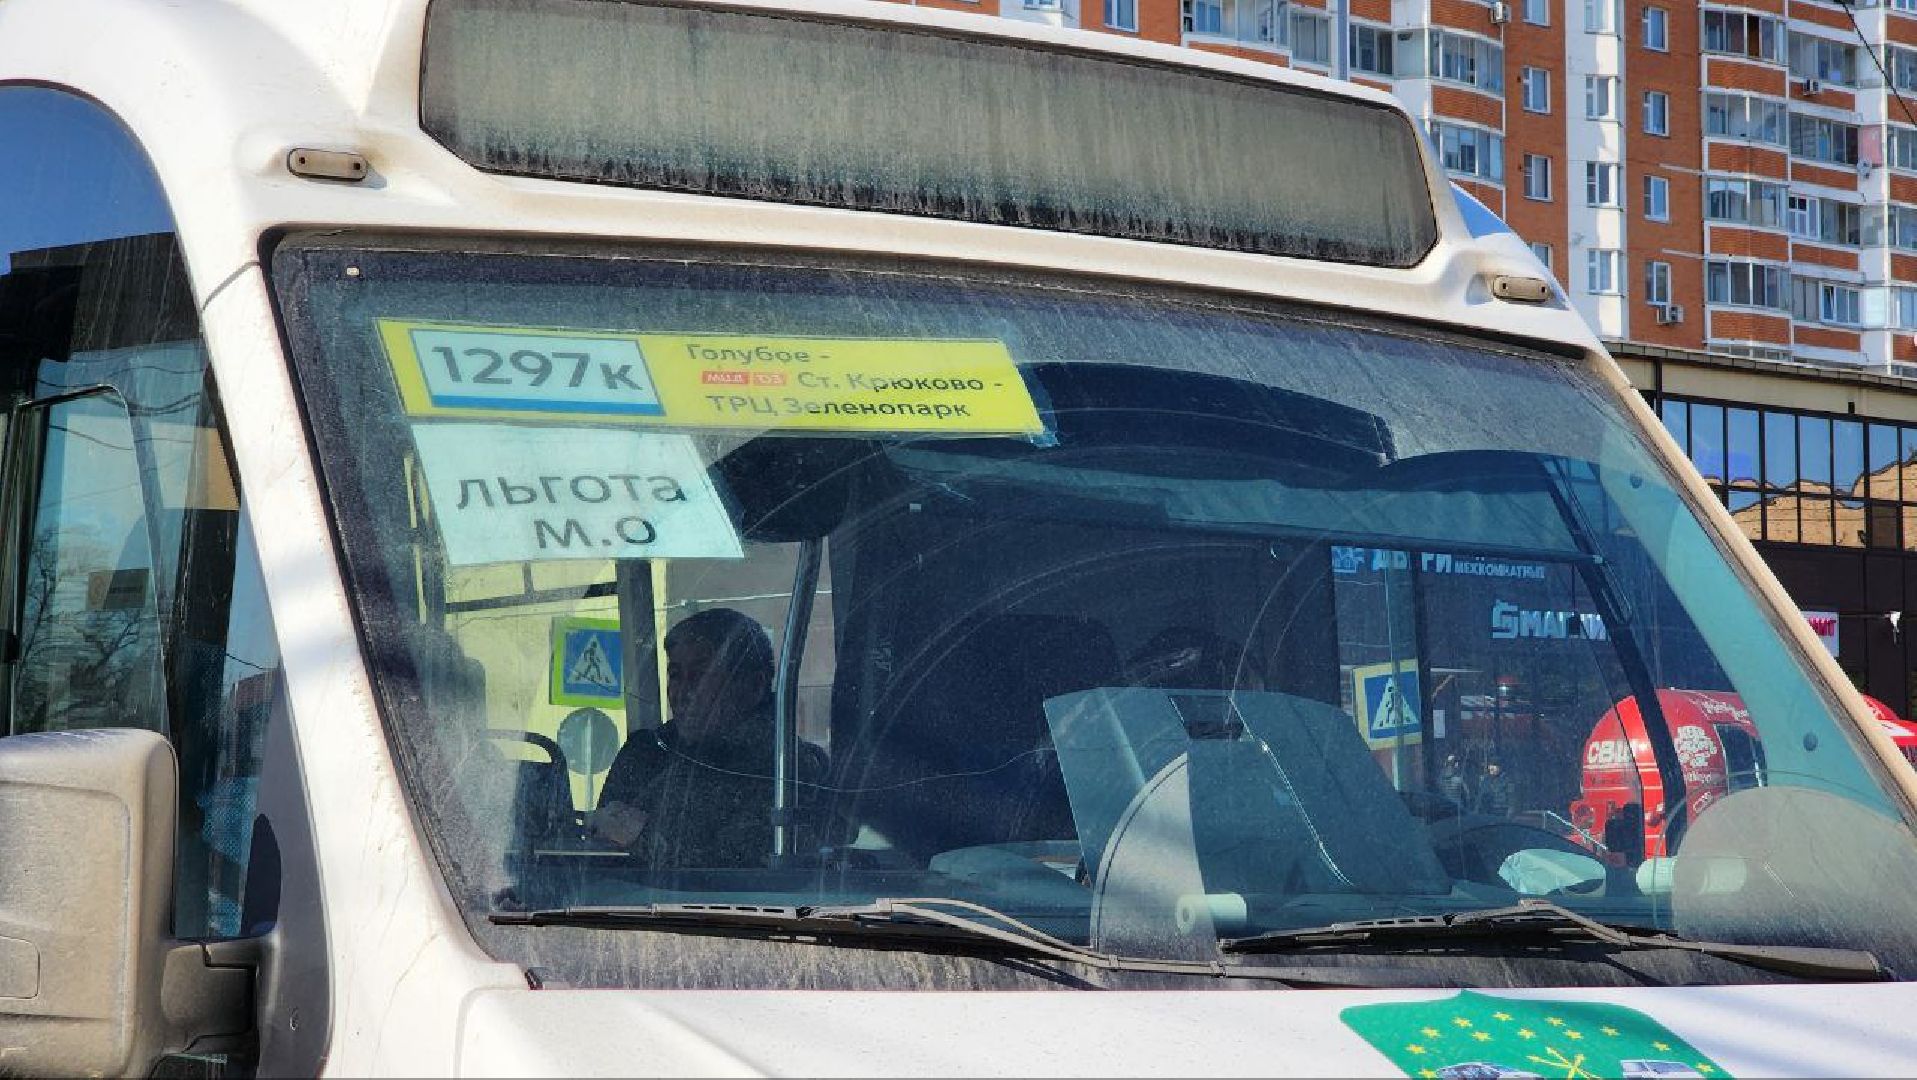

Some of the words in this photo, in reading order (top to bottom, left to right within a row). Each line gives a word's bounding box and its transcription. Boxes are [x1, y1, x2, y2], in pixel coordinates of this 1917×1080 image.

[686, 343, 811, 366] Голубое
[797, 370, 841, 389] Ст.
[845, 373, 985, 393] Крюково
[705, 395, 779, 417] ТРЦ
[783, 397, 972, 420] Зеленопарк
